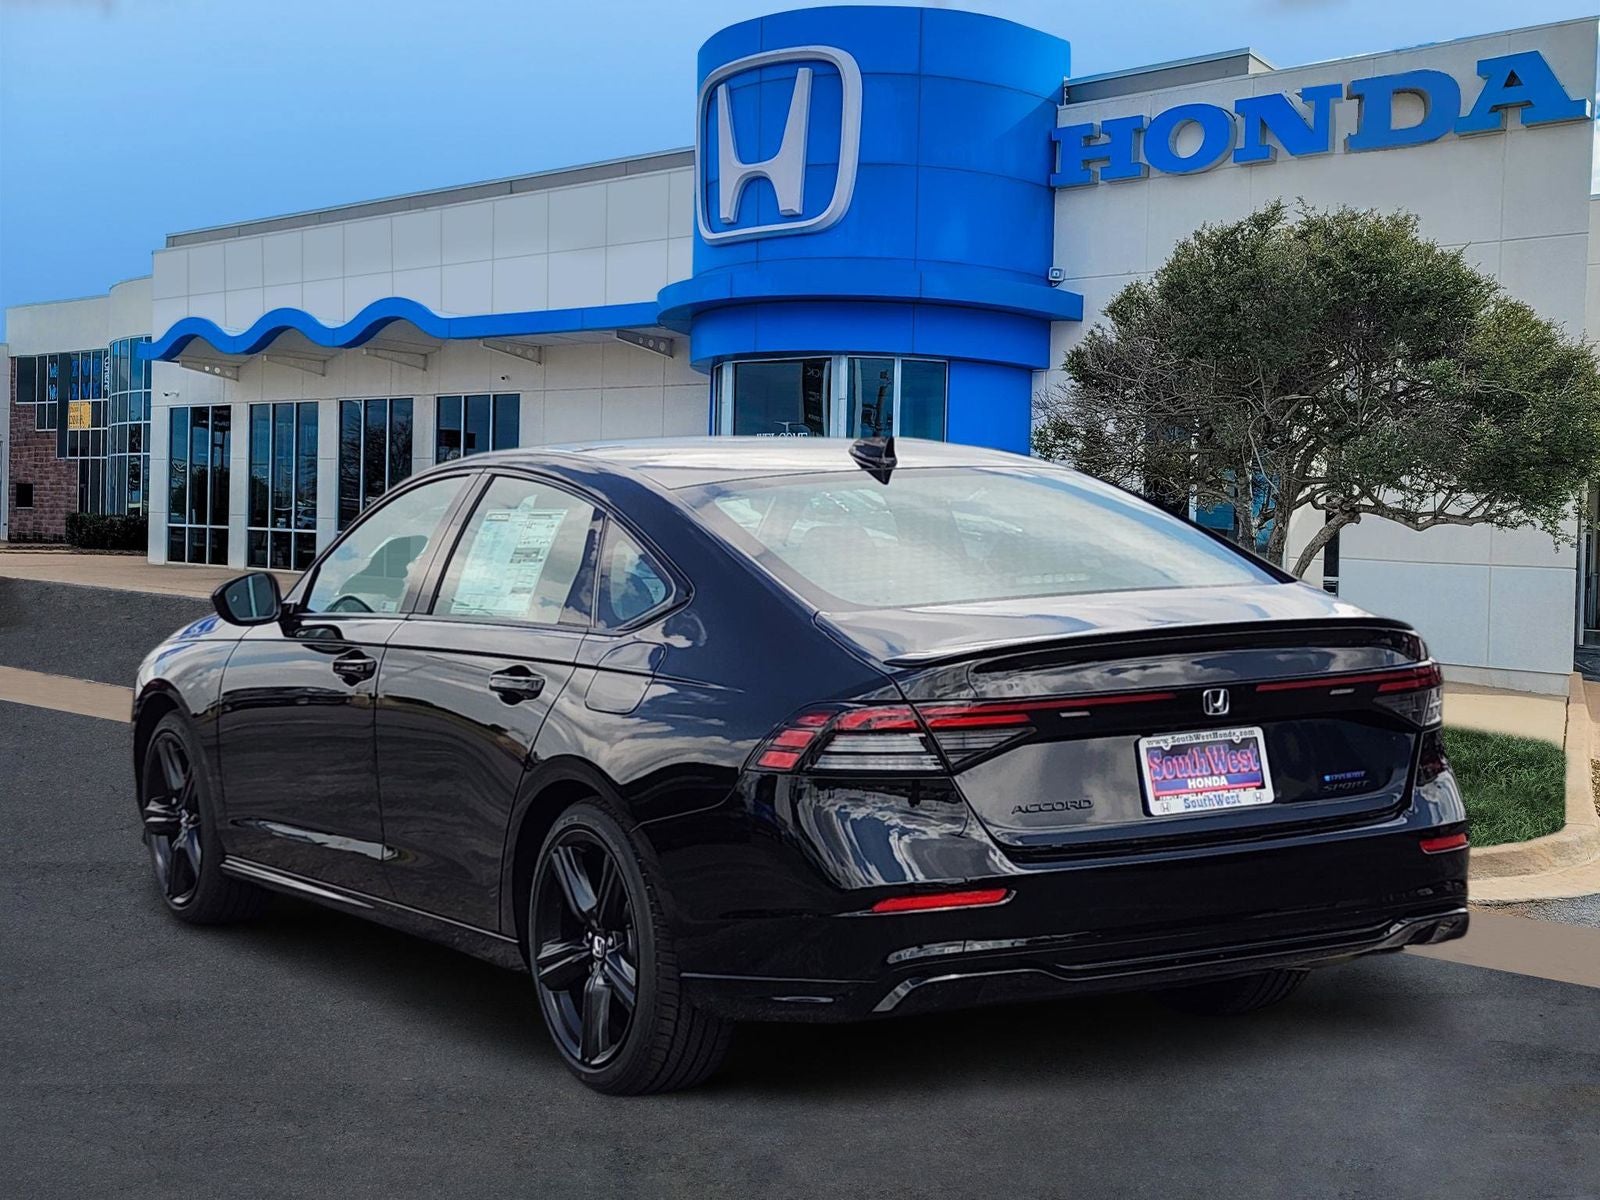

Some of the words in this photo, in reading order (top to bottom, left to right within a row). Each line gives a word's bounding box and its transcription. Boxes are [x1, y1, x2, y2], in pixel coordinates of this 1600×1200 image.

[1050, 50, 1591, 188] HONDA
[1187, 775, 1228, 789] HONDA
[1011, 799, 1094, 815] ACCORD
[1184, 793, 1242, 810] SouthWest
